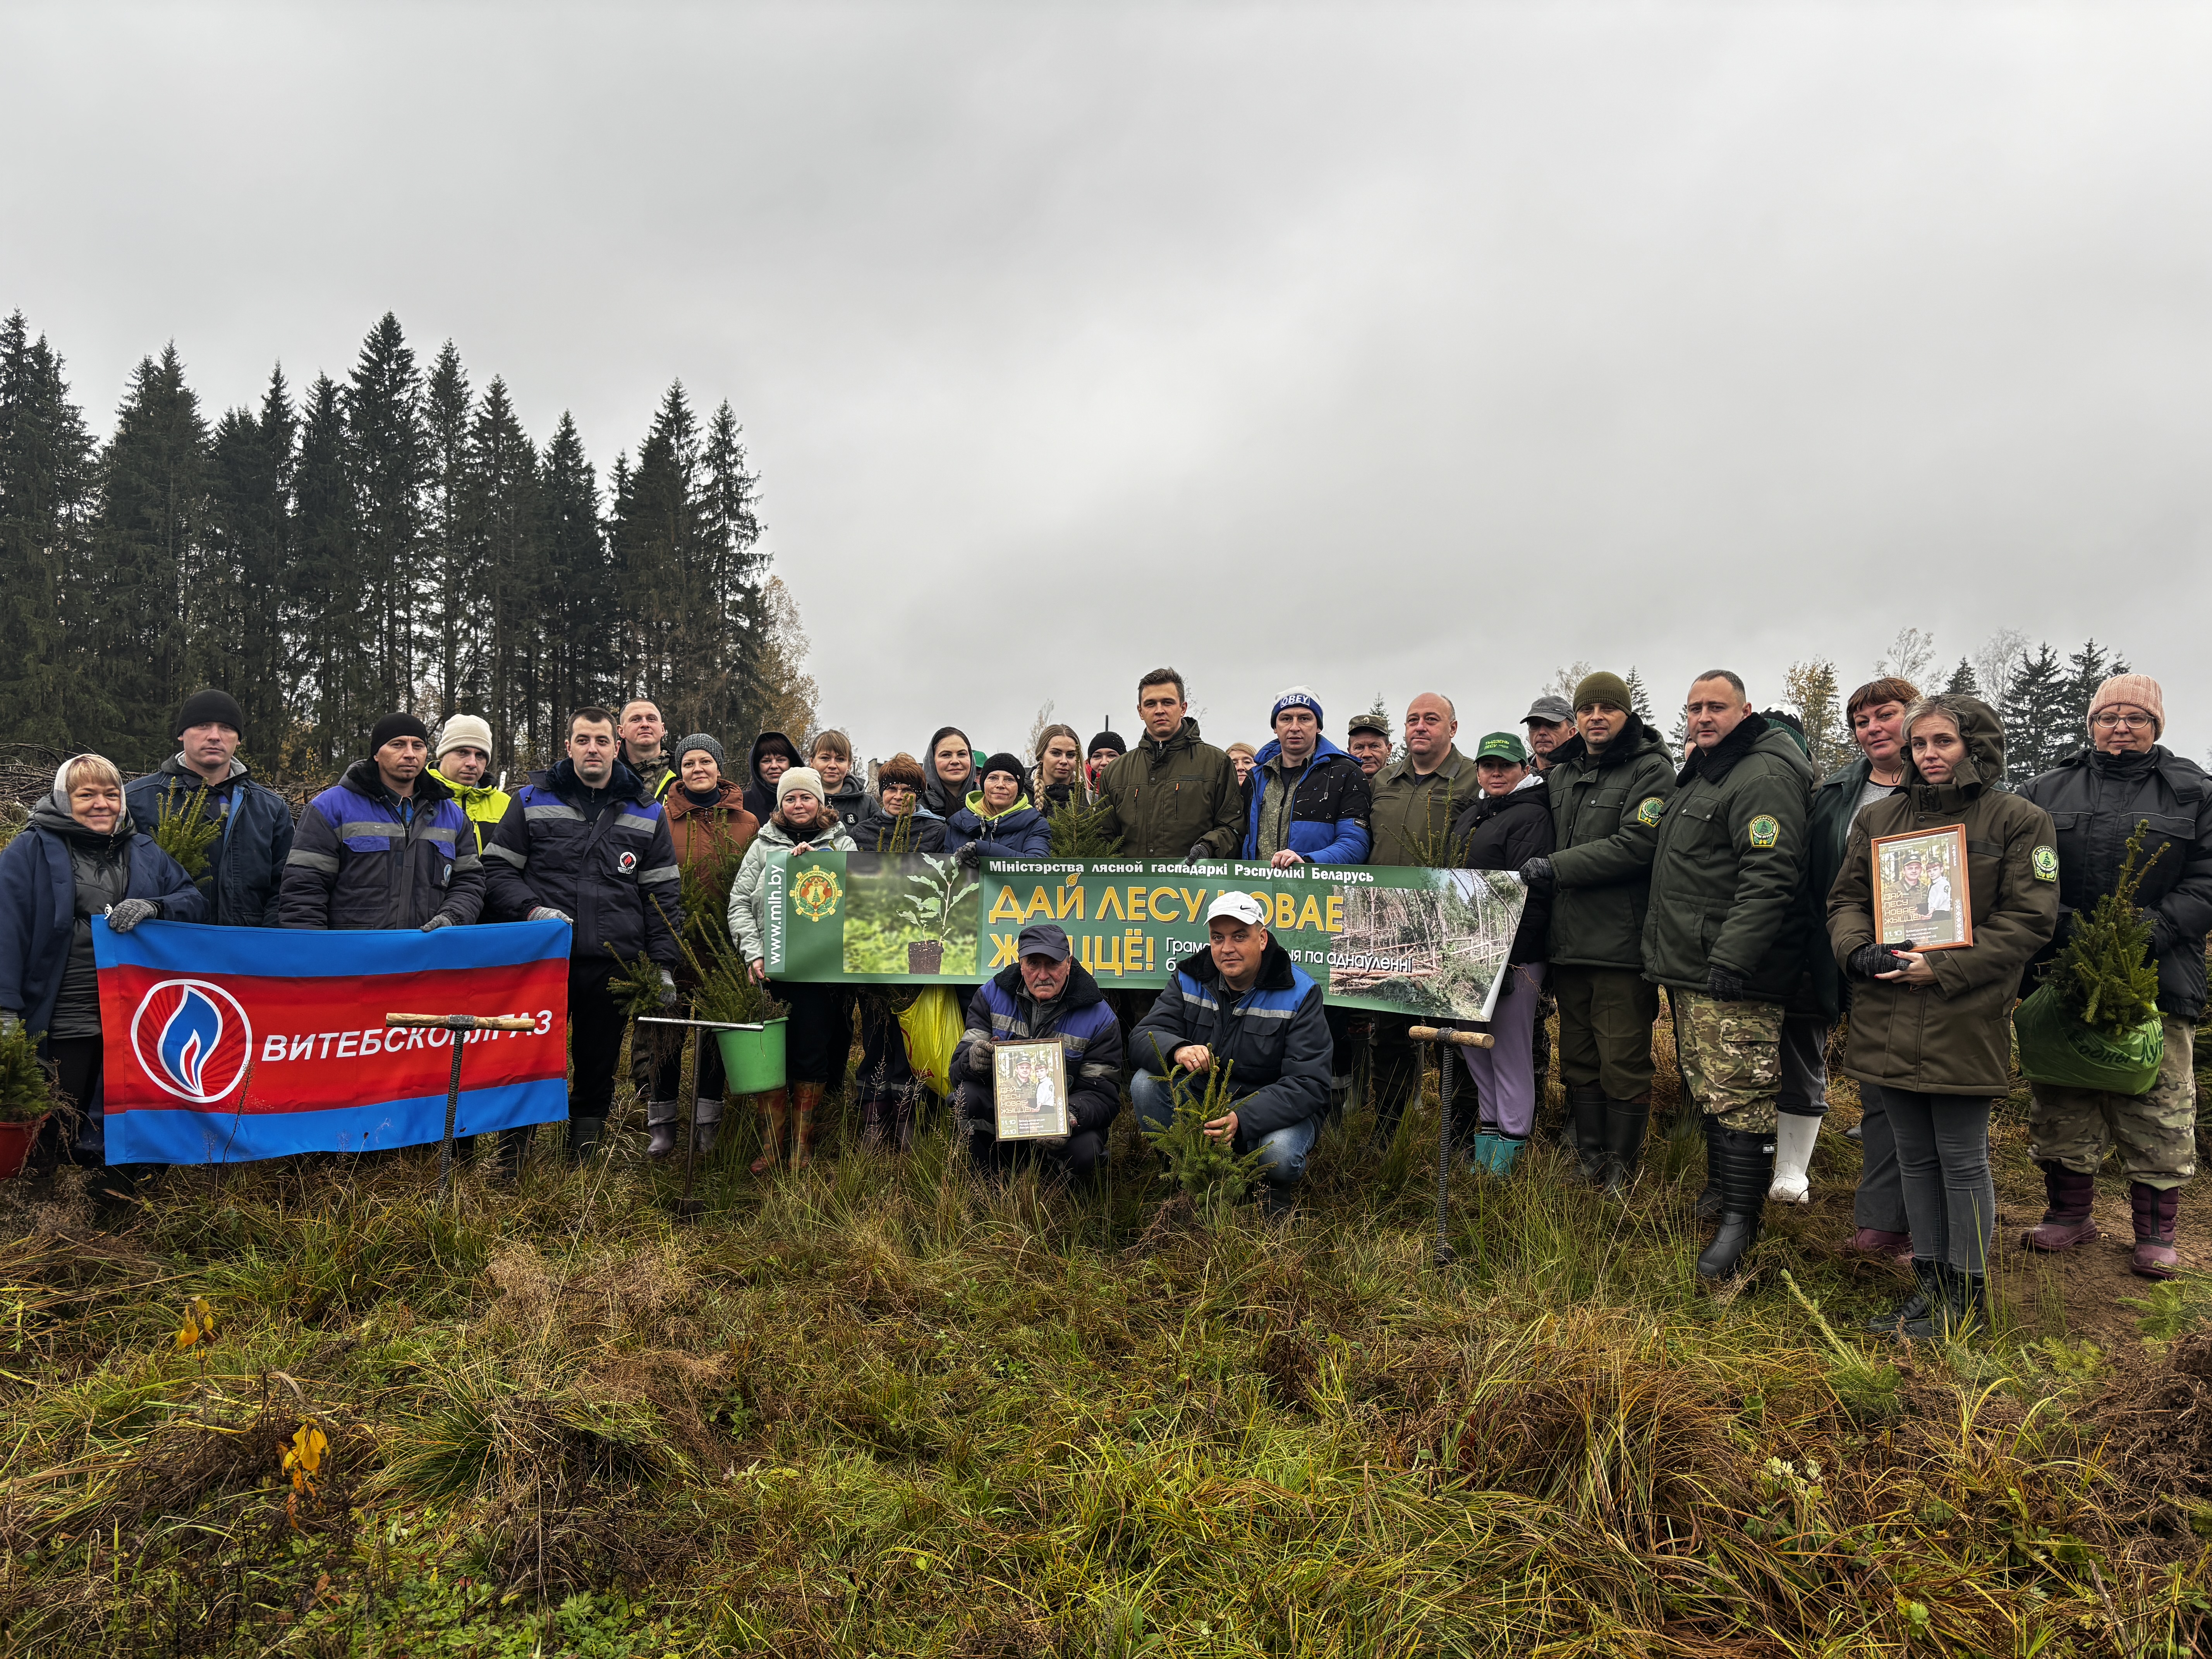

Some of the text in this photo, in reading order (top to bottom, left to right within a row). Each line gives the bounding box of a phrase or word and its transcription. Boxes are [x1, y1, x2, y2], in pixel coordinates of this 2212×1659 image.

[1282, 695, 1308, 705] OBEY
[989, 861, 1374, 883] Міністэрства лясной гаспадаркі Рэспублікі Беларусь
[989, 874, 1343, 932] ДАЙ ЛЕСУ ОВАЕ
[1884, 906, 1915, 917] НОВАЕ
[768, 864, 785, 965] www.mlh.by
[988, 929, 1154, 976] ЖЦЦЁ!
[1305, 951, 1323, 963] па
[1327, 952, 1412, 972] аднаўленні
